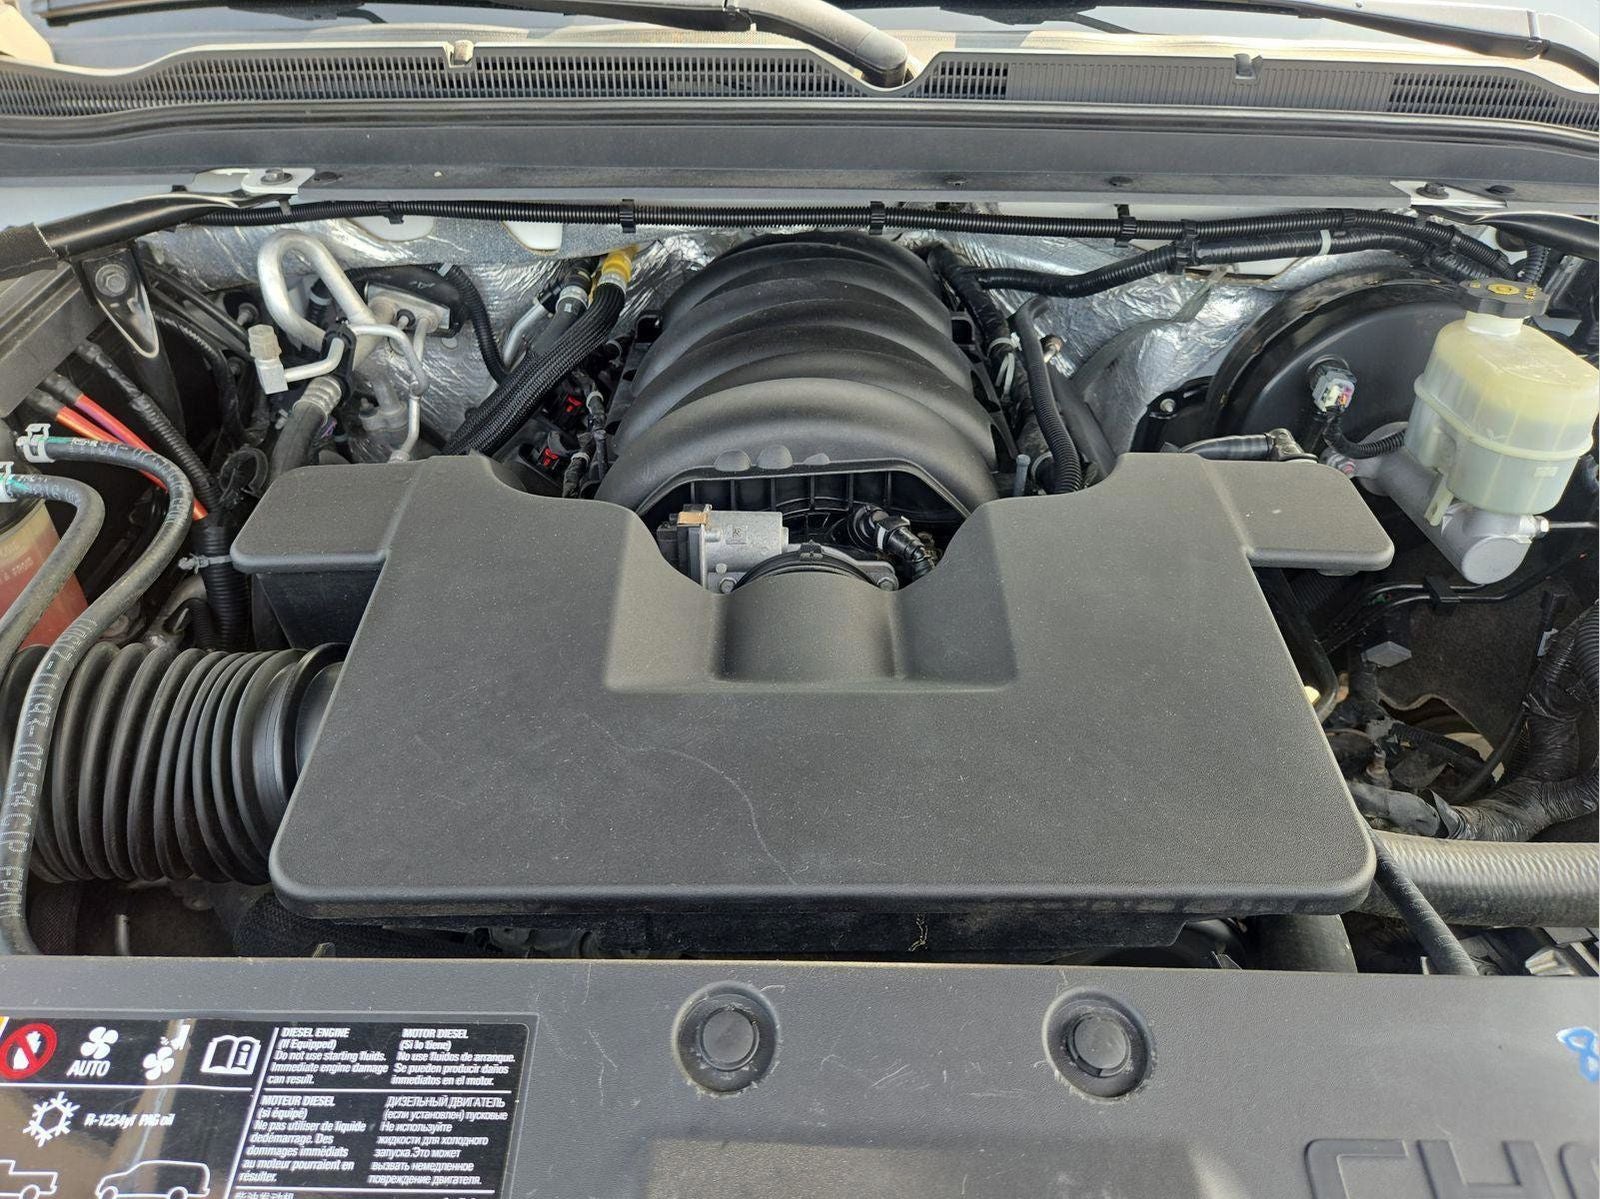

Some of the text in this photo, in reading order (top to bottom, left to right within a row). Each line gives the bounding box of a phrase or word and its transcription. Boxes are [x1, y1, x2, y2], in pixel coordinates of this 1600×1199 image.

[281, 1028, 351, 1037] DIESEL ENGINE
[402, 1029, 468, 1038] MOTOR DIESEL
[279, 1038, 337, 1050] (If Equipped)
[399, 1040, 452, 1051] (Si lo tiene)
[274, 1051, 287, 1060] Do
[289, 1051, 304, 1060] not
[323, 1051, 358, 1062] starting
[359, 1051, 386, 1061] fluids.
[396, 1051, 410, 1060] No
[430, 1052, 459, 1061] fluidos
[460, 1053, 472, 1061] de
[474, 1054, 515, 1063] arranque.
[66, 1060, 110, 1077] AUTO
[271, 1062, 388, 1074] Immediate engine damage
[393, 1063, 509, 1074] Se pueden producir daños
[267, 1074, 314, 1084] can result.
[391, 1075, 494, 1085] inmediatos en el motor.
[261, 1095, 335, 1106] MOTEUR DIESEL
[386, 1095, 505, 1109] ДИЗЕЛЬНЫЙ ДВИГАТЕЛЬ
[257, 1108, 308, 1120] (si équipé)
[384, 1109, 508, 1122] (если установлен) пусковые
[84, 1114, 137, 1128] R-1234yf
[254, 1120, 366, 1133] Ne pas utiliser de liquide
[380, 1122, 453, 1134] Не используйте
[314, 1133, 334, 1144] Des
[377, 1136, 489, 1146] жидкости для холодного
[246, 1146, 349, 1158] dommages immédiats
[431, 1149, 461, 1158] может
[243, 1159, 354, 1172] au moteur pourraient en
[371, 1162, 474, 1171] вызвать немедленное
[239, 1171, 277, 1182] résulter.
[368, 1175, 482, 1186] повреждение двигателя.
